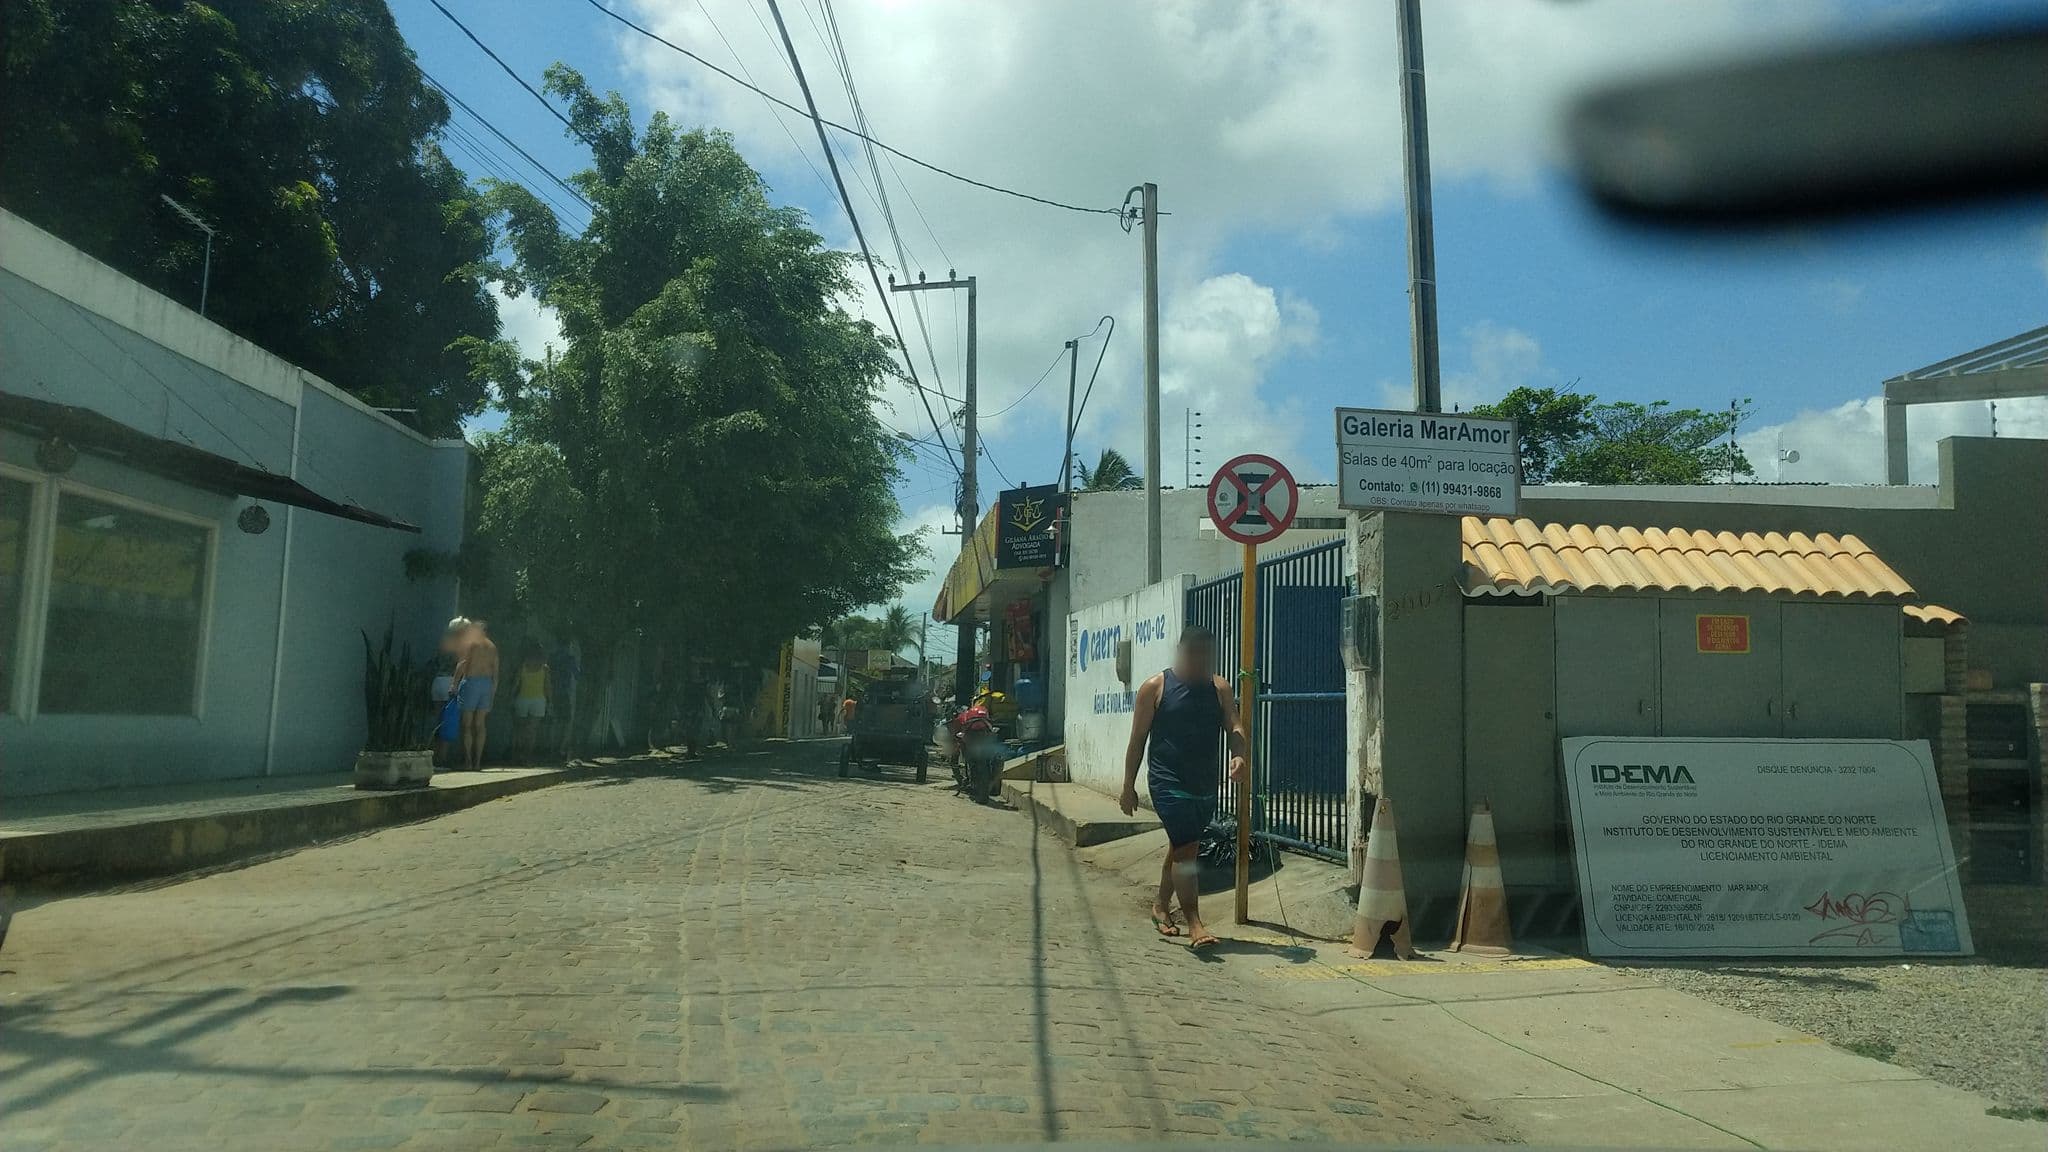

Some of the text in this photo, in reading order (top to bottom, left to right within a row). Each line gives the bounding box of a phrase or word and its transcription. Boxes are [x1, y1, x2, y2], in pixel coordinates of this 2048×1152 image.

[1343, 415, 1511, 444] Galeria MarAmor
[1343, 451, 1378, 467] Salas
[1381, 453, 1397, 468] de
[1437, 459, 1465, 473] para
[1468, 456, 1516, 477] locação
[1359, 478, 1502, 499] Contato: (11) 99431-9868
[1390, 497, 1417, 507] Contato
[1590, 764, 1696, 784] IDEMA
[1756, 765, 1790, 774] DISQUE
[1642, 815, 1877, 825] GOVERNO DO ESTADO DO RIO GRANDE DO NORTE
[1602, 827, 1654, 837] INSTITUTO
[1656, 827, 1671, 837] DE
[1671, 827, 1766, 837] DESENVOLVIMENTO
[1837, 827, 1843, 837] E
[1845, 827, 1869, 837] MEIO
[1871, 827, 1919, 837] AMBIENTE
[1681, 839, 1696, 849] DO
[1698, 839, 1715, 849] RIO
[1717, 839, 1758, 849] GRANDE
[1760, 839, 1775, 849] DO
[1776, 839, 1810, 849] NORTE
[1817, 839, 1849, 849] IDEMA
[1700, 851, 1833, 861] LICENCIAMENTO AMBIENTAL
[1611, 884, 1635, 892] NOME
